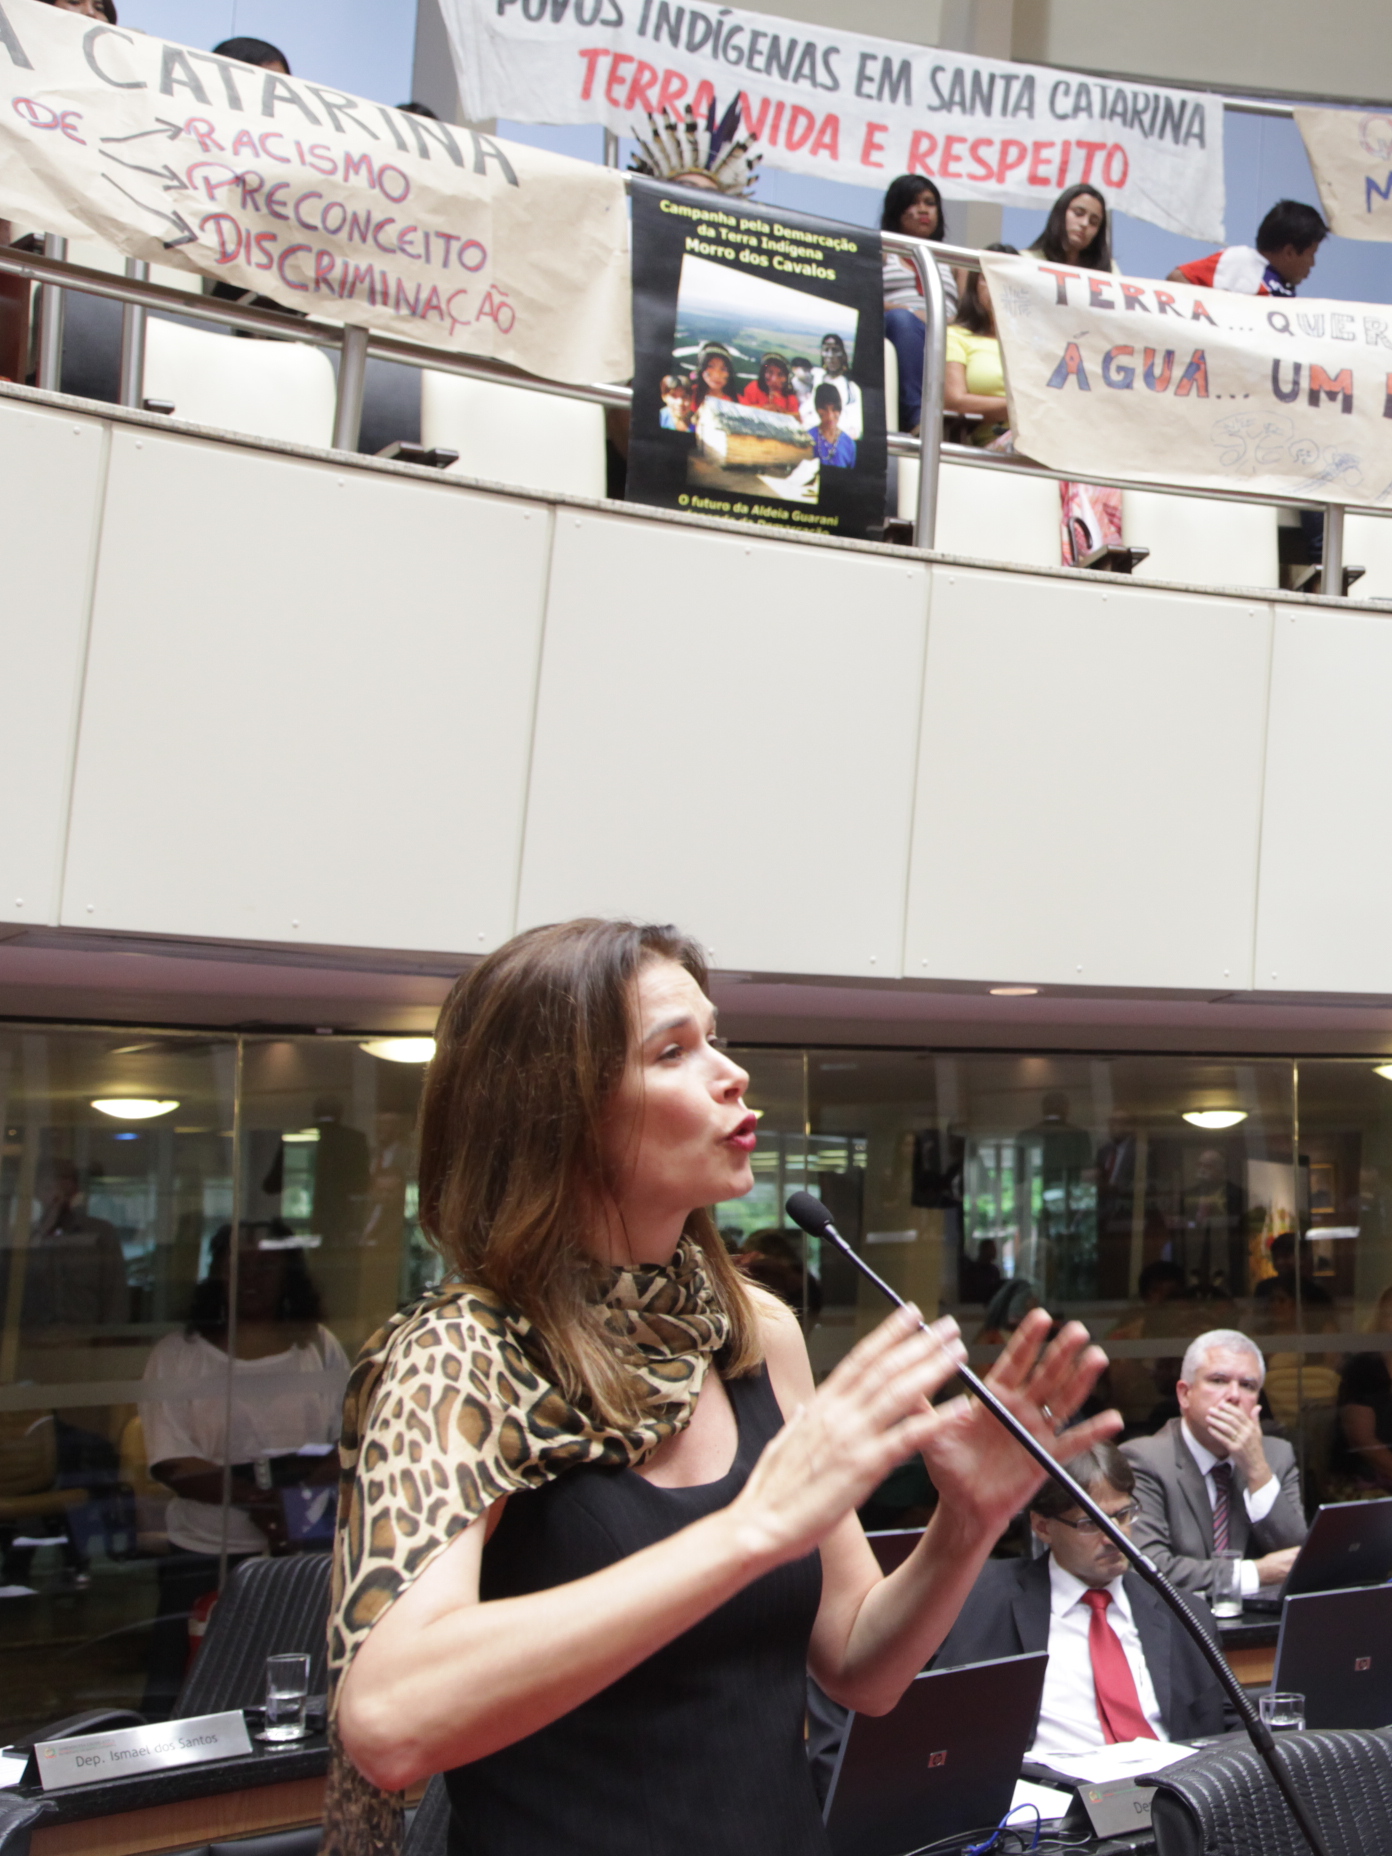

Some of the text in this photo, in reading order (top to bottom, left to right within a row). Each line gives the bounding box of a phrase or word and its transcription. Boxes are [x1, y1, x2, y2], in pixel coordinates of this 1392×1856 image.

[637, 0, 841, 92] INDÍGENAS
[854, 53, 912, 106] EM
[927, 65, 1036, 119] SANTA
[1048, 80, 1206, 149] CATARINA
[13, 98, 87, 146] DE
[82, 25, 519, 188] CATARINA
[579, 48, 716, 124] TERRA
[860, 121, 889, 168] E
[907, 130, 1129, 189] RESPEITO
[183, 117, 410, 203] RACISMO
[186, 162, 487, 272] PRECONCEITO
[659, 199, 858, 253] Campanha pela Demarcação
[697, 223, 824, 261] da Terra Indígena
[200, 213, 516, 336] DISCRIMINAÇÃO
[685, 236, 837, 281] Morro dos Cavalos
[1271, 358, 1353, 415] UM
[678, 493, 690, 506] O
[691, 495, 731, 512] futuro
[732, 502, 749, 514] da
[751, 504, 790, 520] Aldeia
[791, 510, 839, 527] Guarani
[75, 1755, 105, 1768] Dep.
[110, 1746, 150, 1761] Ismael
[154, 1741, 176, 1753] dos
[178, 1733, 218, 1750] Santos
[1133, 1801, 1152, 1814] De
